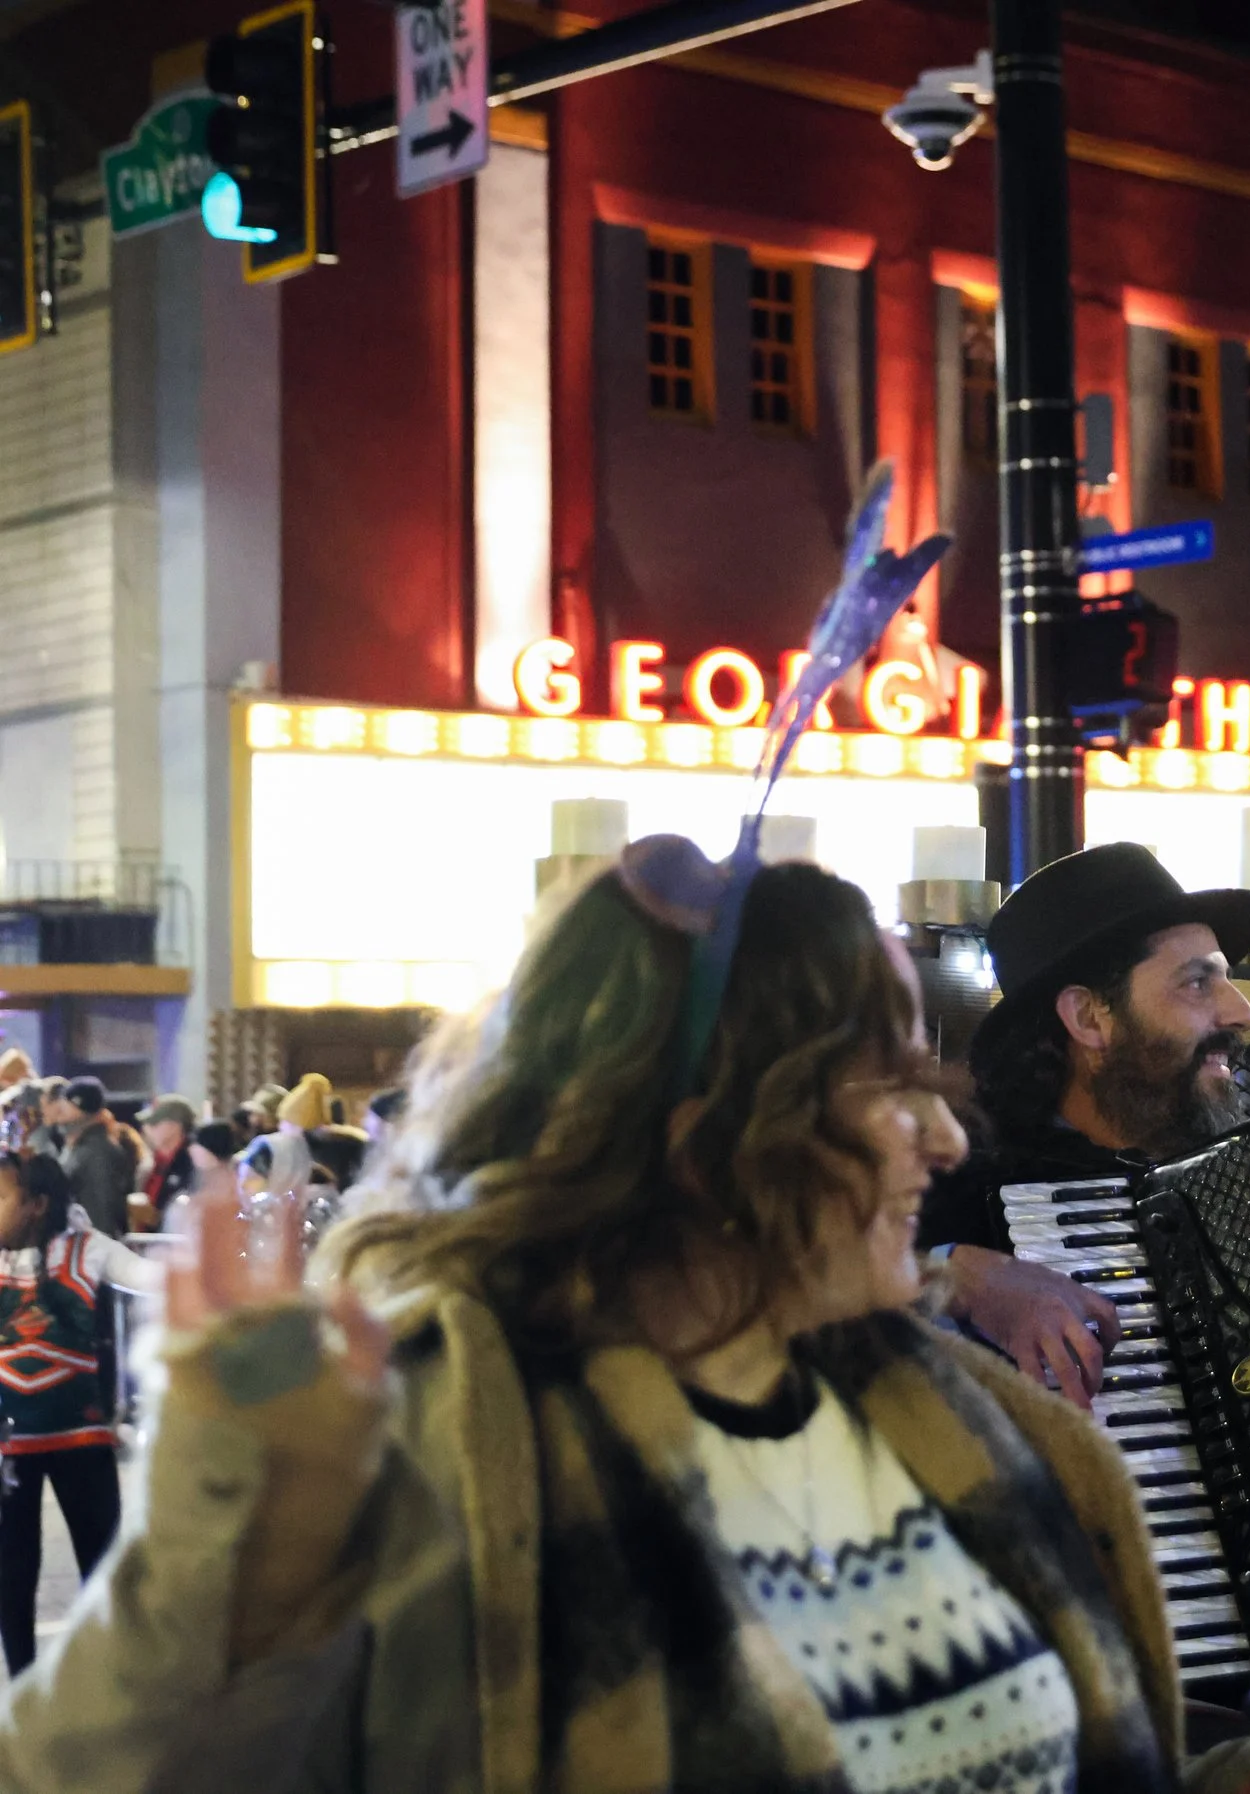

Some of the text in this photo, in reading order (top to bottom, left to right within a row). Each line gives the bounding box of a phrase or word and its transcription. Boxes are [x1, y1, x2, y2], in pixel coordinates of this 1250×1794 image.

[410, 0, 470, 56] ONE
[413, 45, 475, 107] WAY
[513, 637, 1012, 740] GEOGI
